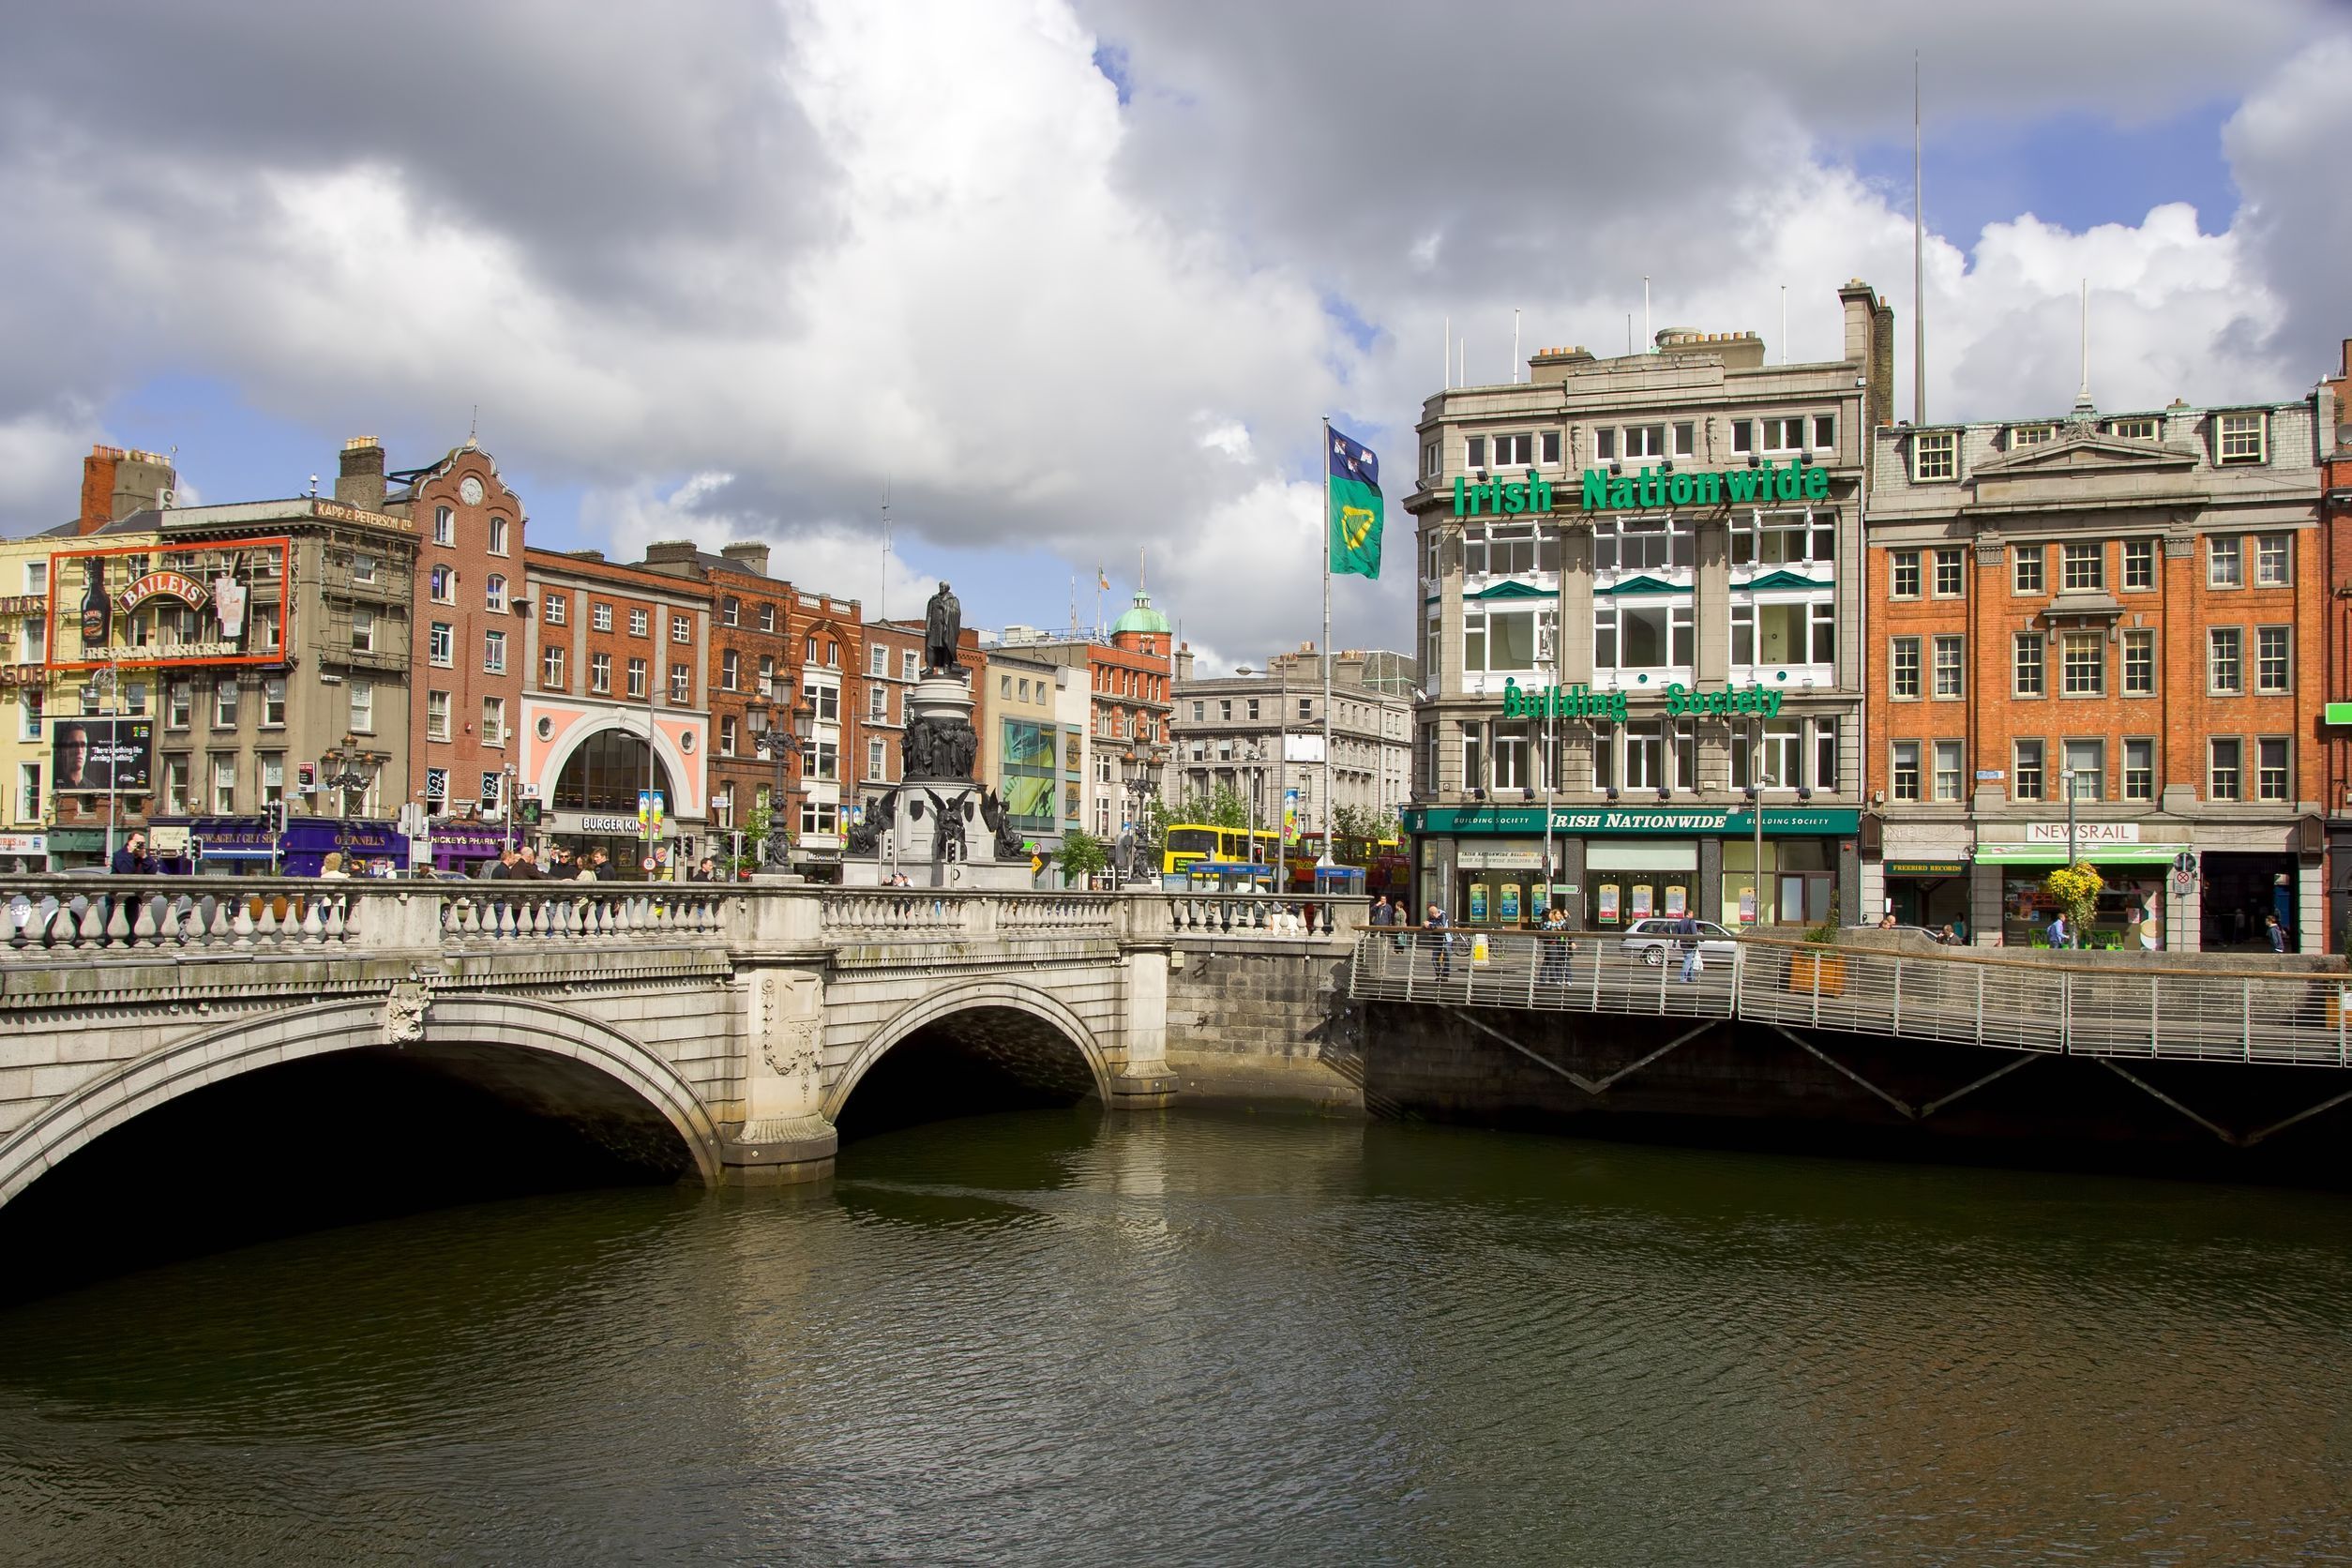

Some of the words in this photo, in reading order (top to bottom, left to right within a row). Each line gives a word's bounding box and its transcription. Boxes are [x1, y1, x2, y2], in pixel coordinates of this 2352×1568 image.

[1454, 470, 1552, 517] Irish
[1582, 458, 1830, 511] Nationwide
[318, 502, 345, 519] KAPP
[354, 509, 399, 530] PETERSON
[124, 576, 201, 608] BAILEYS
[194, 641, 238, 656] CREAM
[1503, 685, 1628, 723] Building
[1666, 682, 1784, 719] Society
[582, 818, 622, 831] BURGER
[625, 819, 641, 831] KIN
[1545, 813, 1602, 829] IRISH
[1605, 812, 1727, 829] NATIONWIDE
[262, 833, 281, 844] SHP
[431, 836, 467, 845] HICKEY'S
